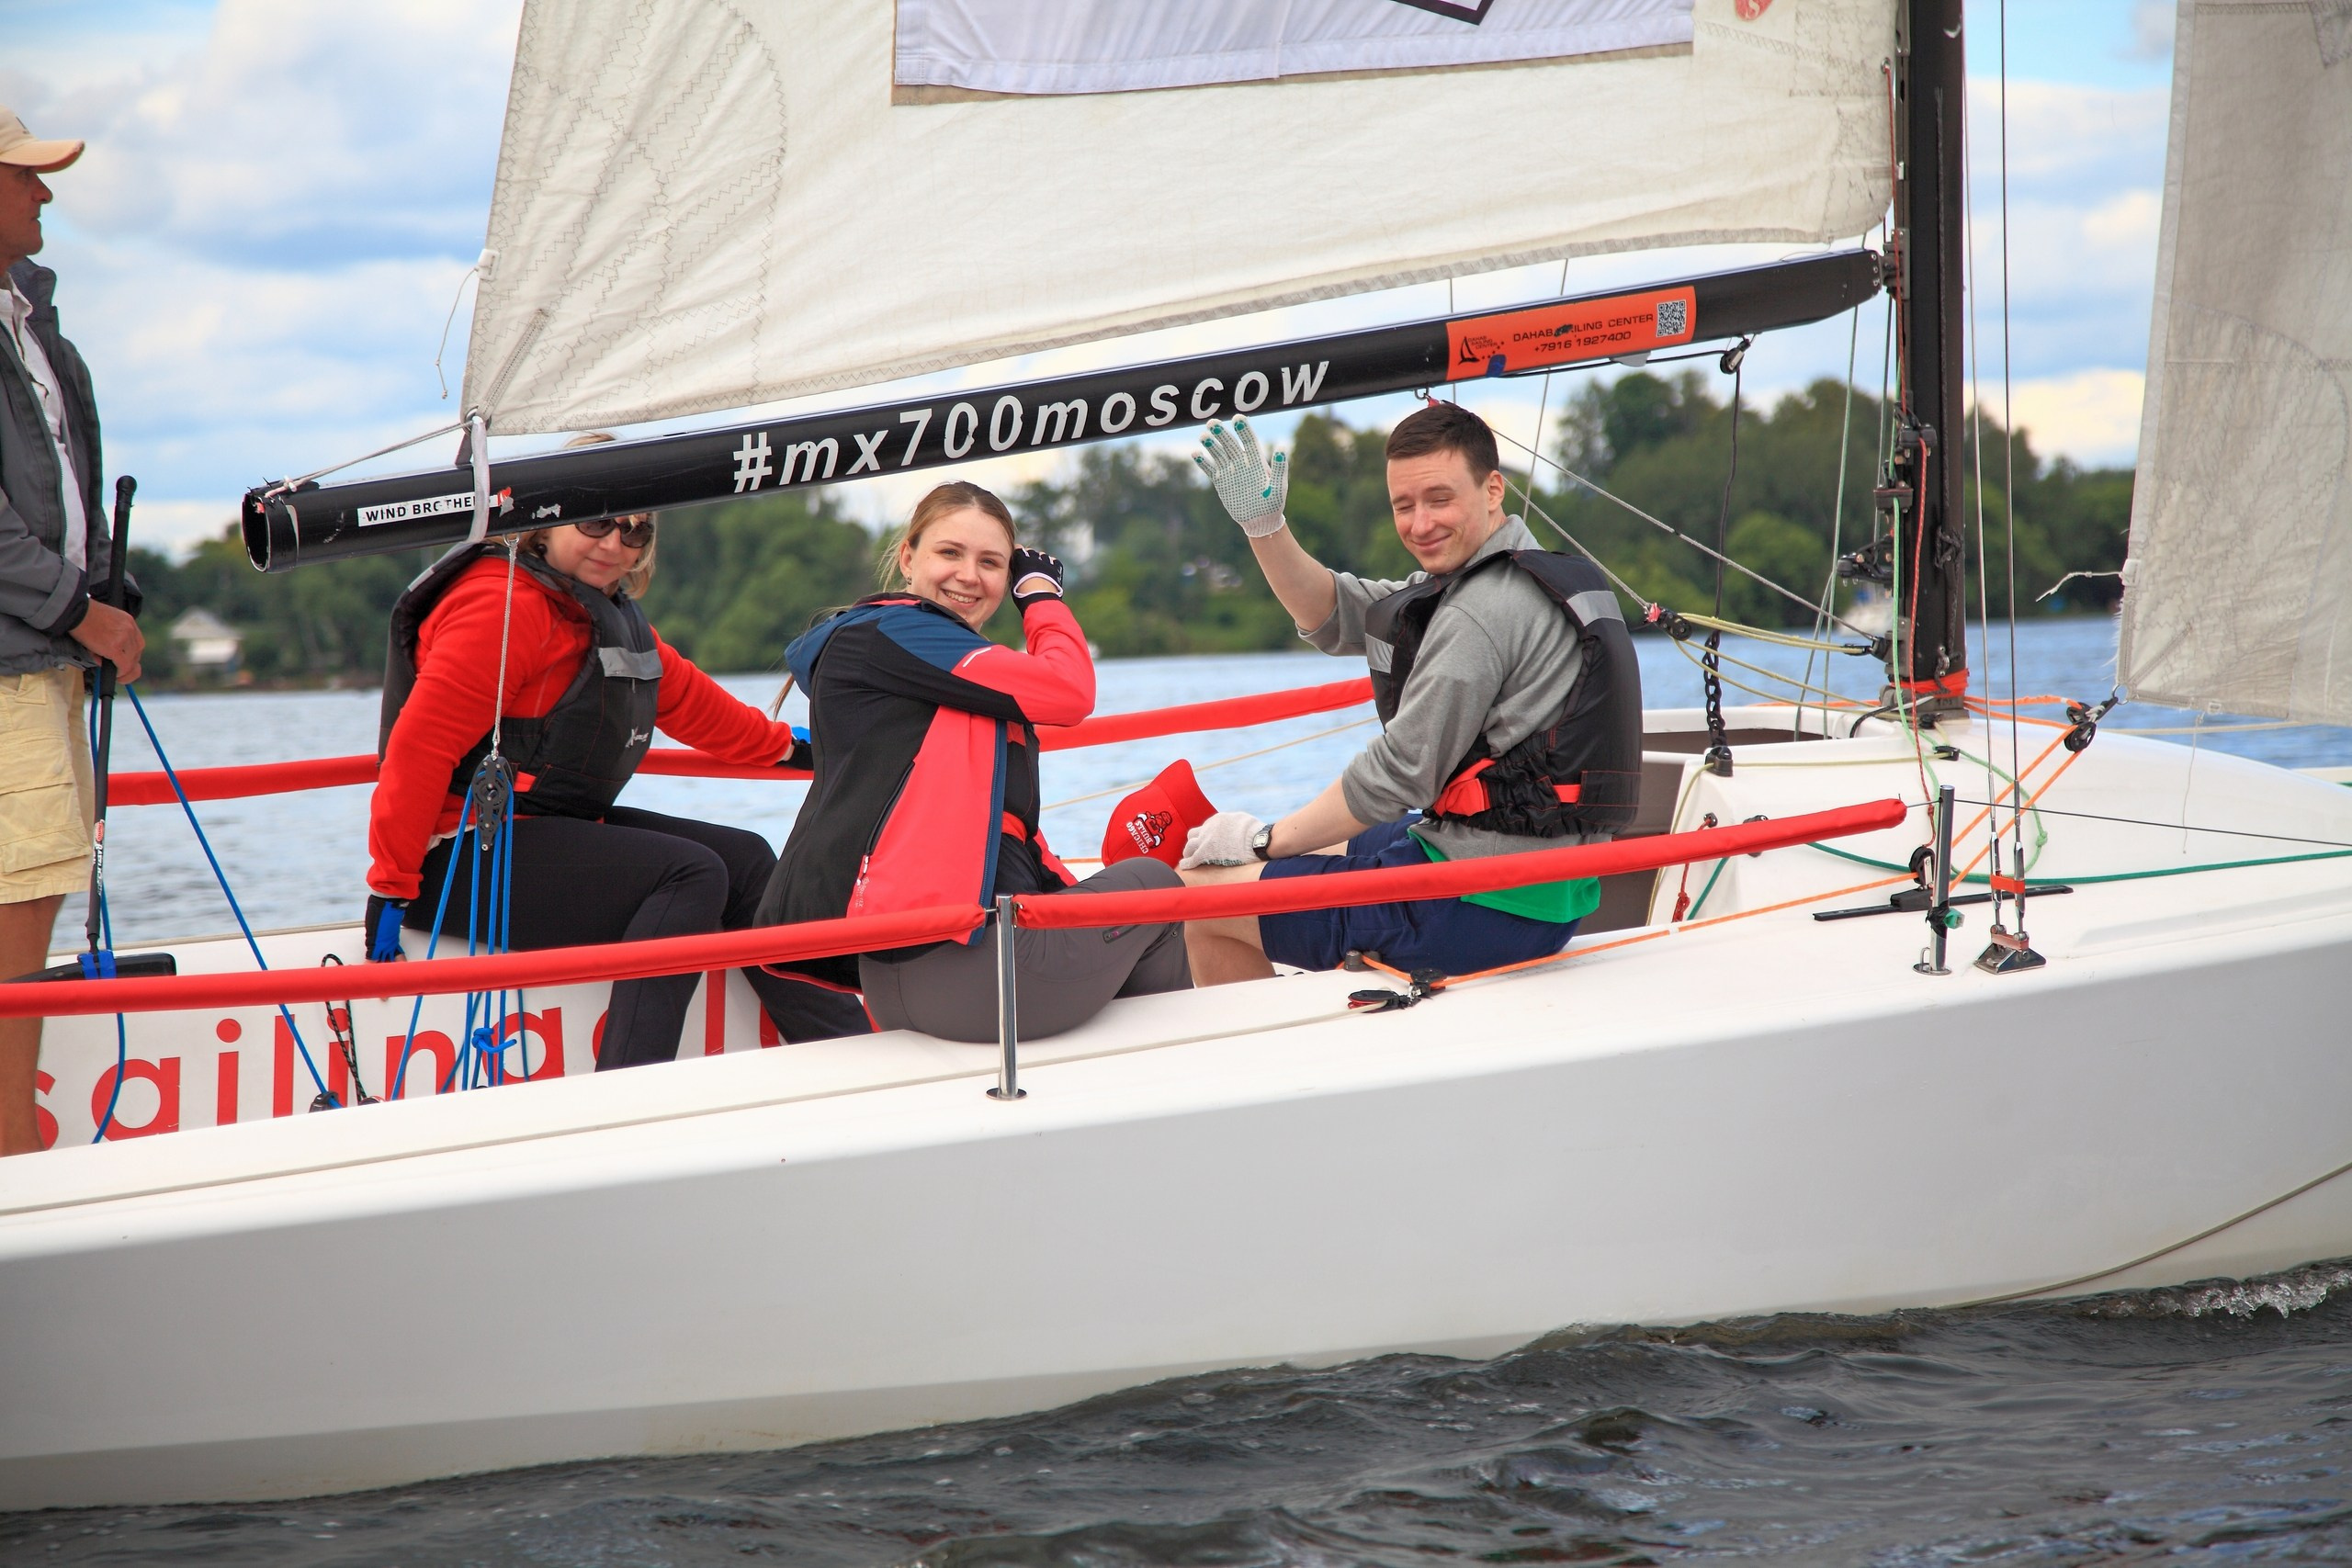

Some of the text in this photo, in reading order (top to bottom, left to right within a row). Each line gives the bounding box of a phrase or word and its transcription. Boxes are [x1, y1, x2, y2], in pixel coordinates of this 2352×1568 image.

[1513, 313, 1654, 343] DAHAB ILING CENTER
[1533, 331, 1632, 353] +7916 1927400
[733, 361, 1329, 493] #mx700moscow
[366, 493, 492, 523] WIND BROTHE
[1126, 821, 1149, 854] CHICAGO
[1135, 819, 1154, 845] BULLS
